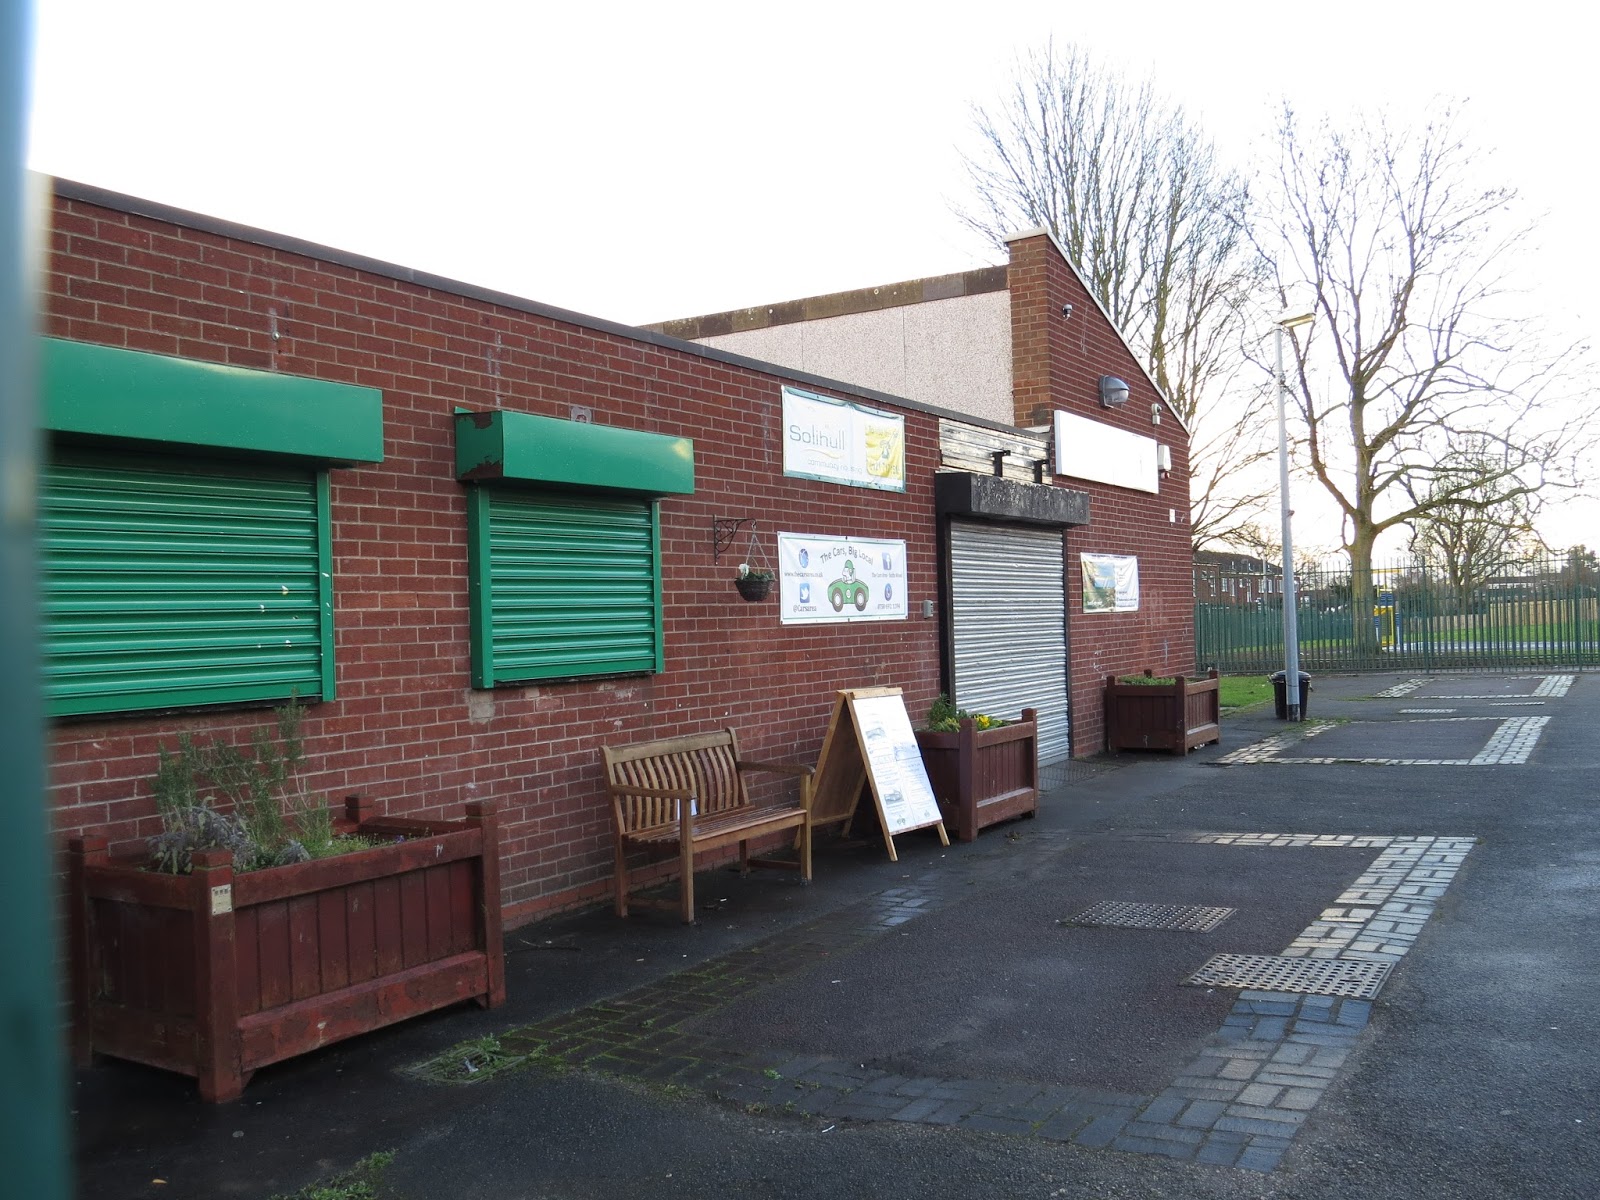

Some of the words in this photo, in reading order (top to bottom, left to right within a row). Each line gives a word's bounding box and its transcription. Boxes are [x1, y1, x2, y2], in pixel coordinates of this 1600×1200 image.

[789, 424, 845, 451] Solihull
[819, 552, 832, 564] The
[848, 545, 858, 559] Big
[859, 549, 874, 565] Local
